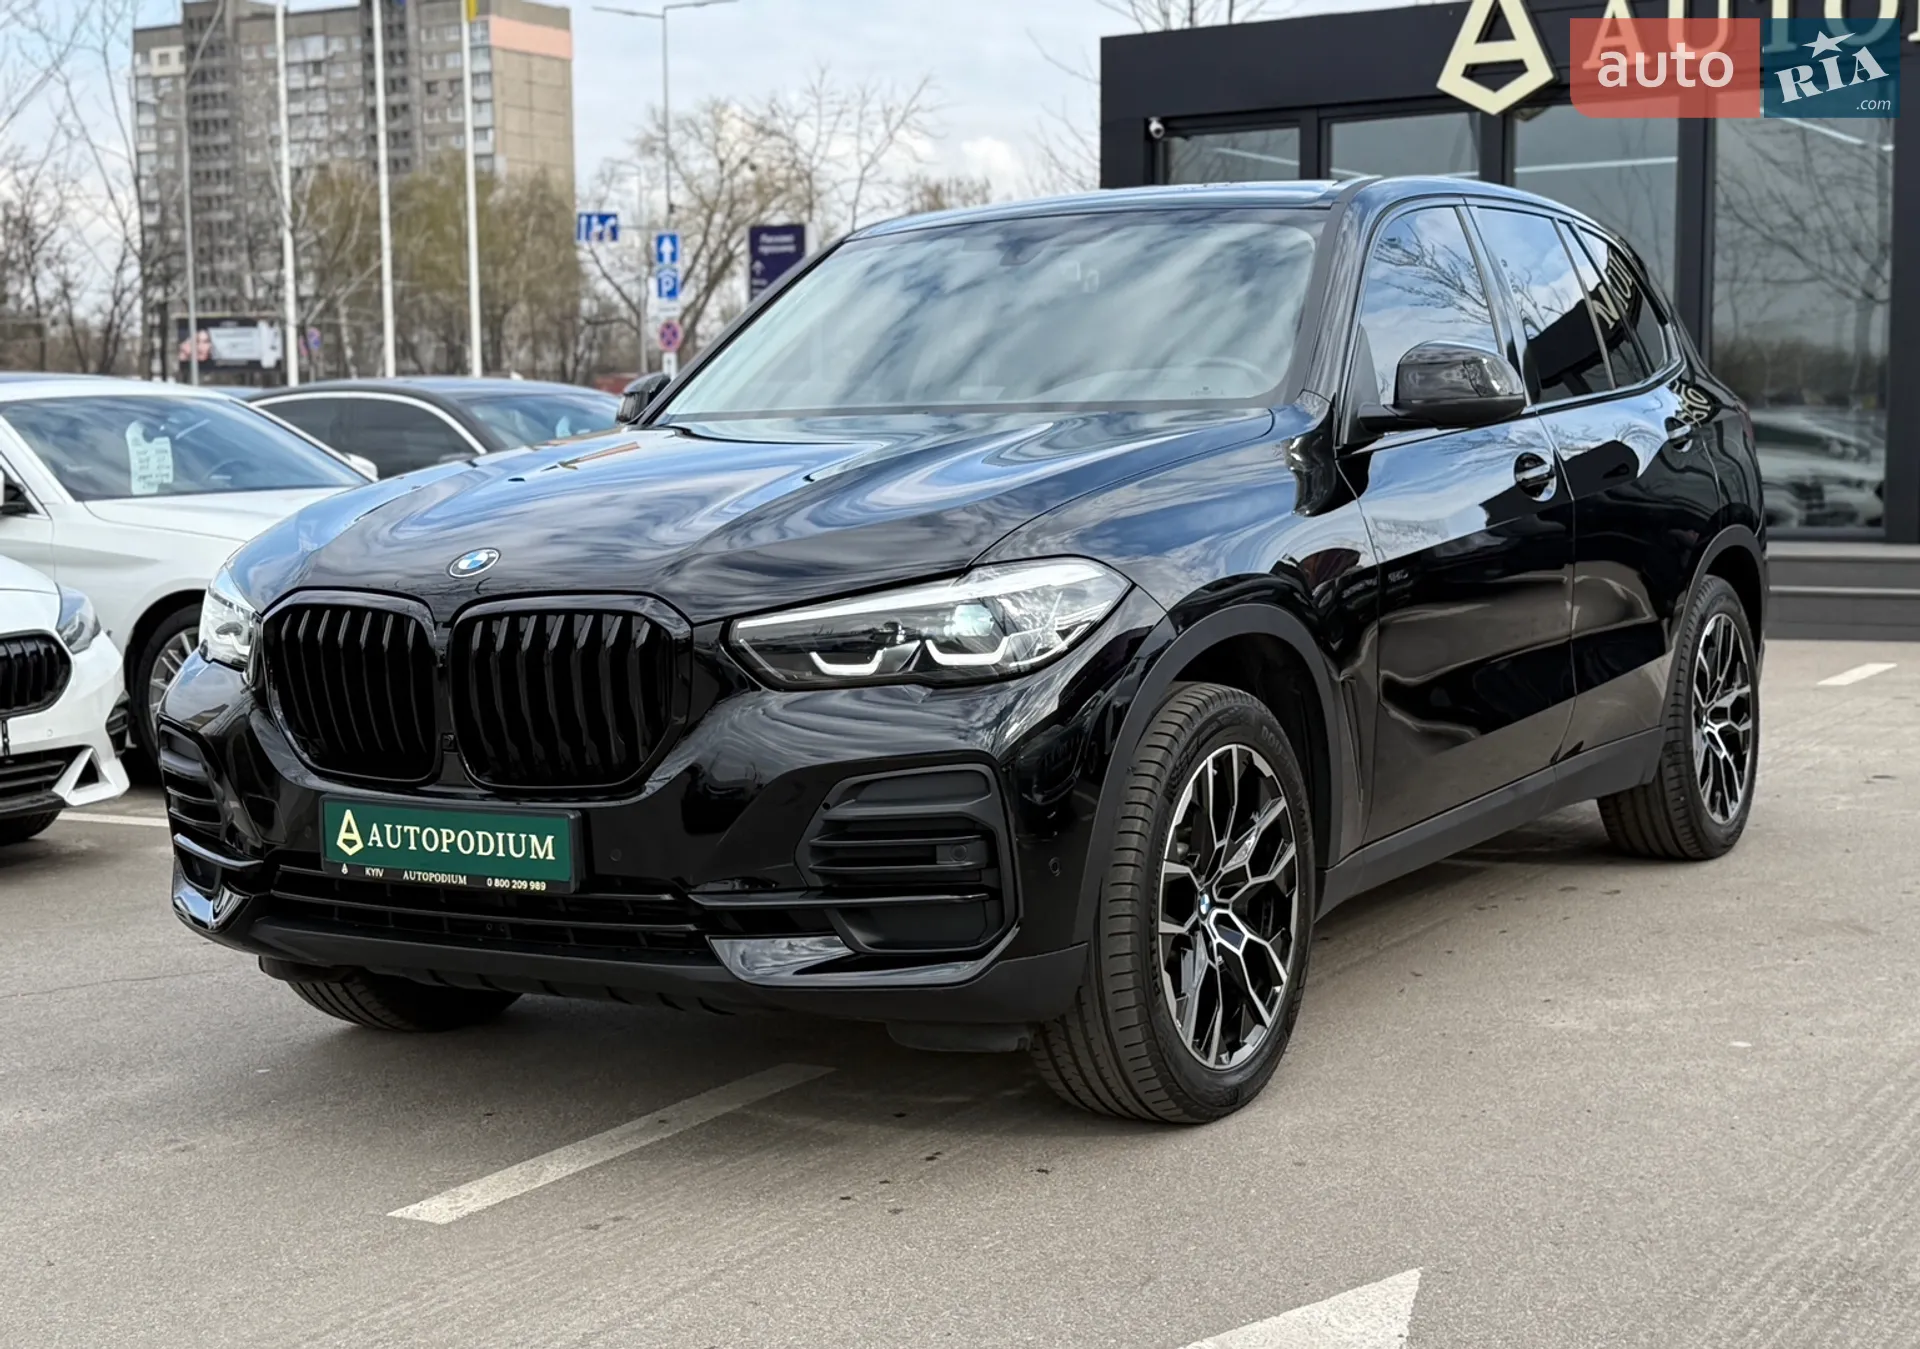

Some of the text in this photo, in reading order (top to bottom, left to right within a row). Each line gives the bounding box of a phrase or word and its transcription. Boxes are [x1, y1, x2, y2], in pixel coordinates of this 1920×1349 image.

[367, 822, 556, 860] AUTOPODIUM
[364, 866, 547, 891] KYIV AUTOPODIUM 0 800 209 989
